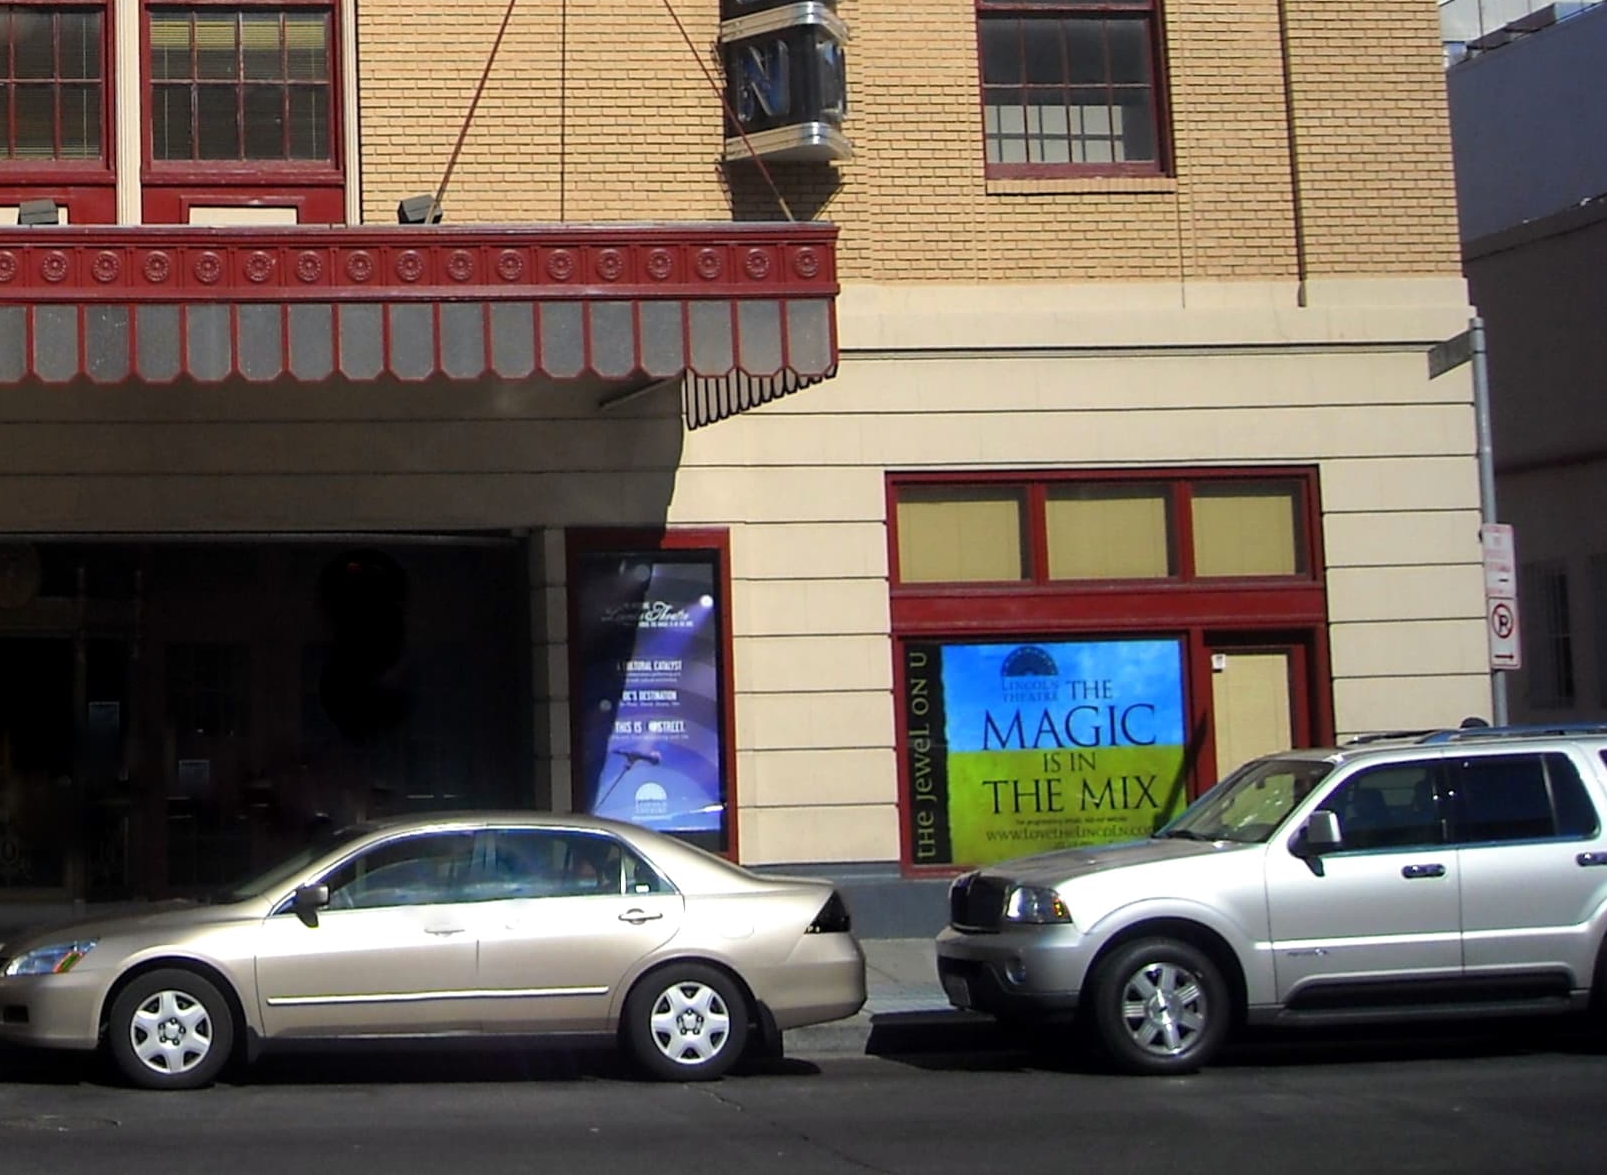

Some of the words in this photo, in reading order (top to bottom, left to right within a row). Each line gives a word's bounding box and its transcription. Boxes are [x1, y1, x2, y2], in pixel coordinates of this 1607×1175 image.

[1067, 679, 1114, 701] THE
[981, 702, 1157, 751] MAGIC
[1043, 752, 1062, 773] IS
[1069, 751, 1096, 772] IN
[982, 778, 1065, 814] THE
[1078, 775, 1162, 811] MIX
